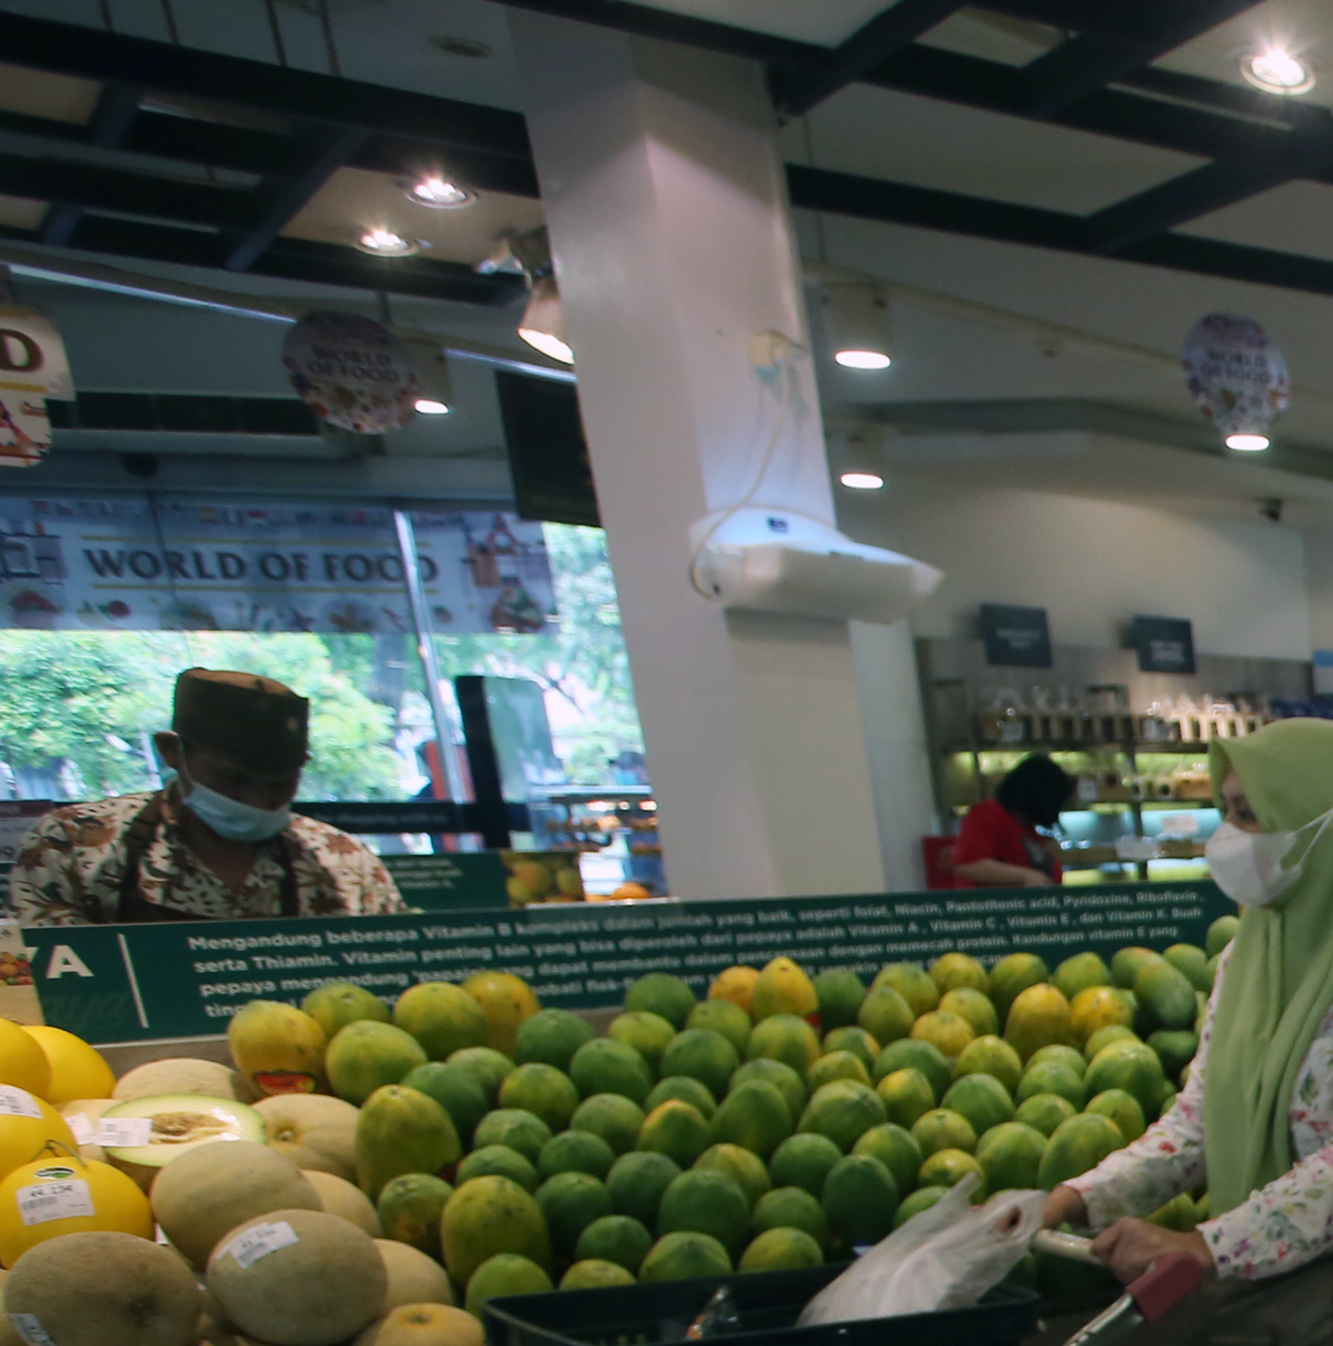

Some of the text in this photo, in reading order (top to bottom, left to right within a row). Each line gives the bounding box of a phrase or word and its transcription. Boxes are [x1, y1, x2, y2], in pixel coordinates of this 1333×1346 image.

[83, 549, 440, 582] WORLD OF FOOD
[188, 931, 323, 950] Mengandung
[324, 927, 418, 946] beberapa
[421, 923, 494, 940] Vitamin
[497, 922, 511, 937] B
[715, 912, 755, 927] yang
[194, 960, 247, 973] serta
[252, 955, 338, 970] Thiamin.
[342, 951, 417, 965] Vitamin
[421, 946, 492, 963] penting
[497, 943, 529, 956] lain
[533, 942, 576, 957] yang
[579, 939, 614, 953] bisa
[619, 936, 697, 952] diperoleh
[701, 931, 732, 946] dari
[849, 924, 902, 937] Vitamin
[931, 919, 982, 932] Vitamin
[1008, 915, 1056, 928] Vitamin
[1079, 912, 1102, 923] dan
[1108, 909, 1153, 922] Vitamin
[199, 979, 276, 998] pepaya
[592, 957, 680, 971] membantu
[957, 935, 1009, 950] protein.
[1012, 931, 1084, 947] Kandungan
[1087, 928, 1133, 940] vitamin
